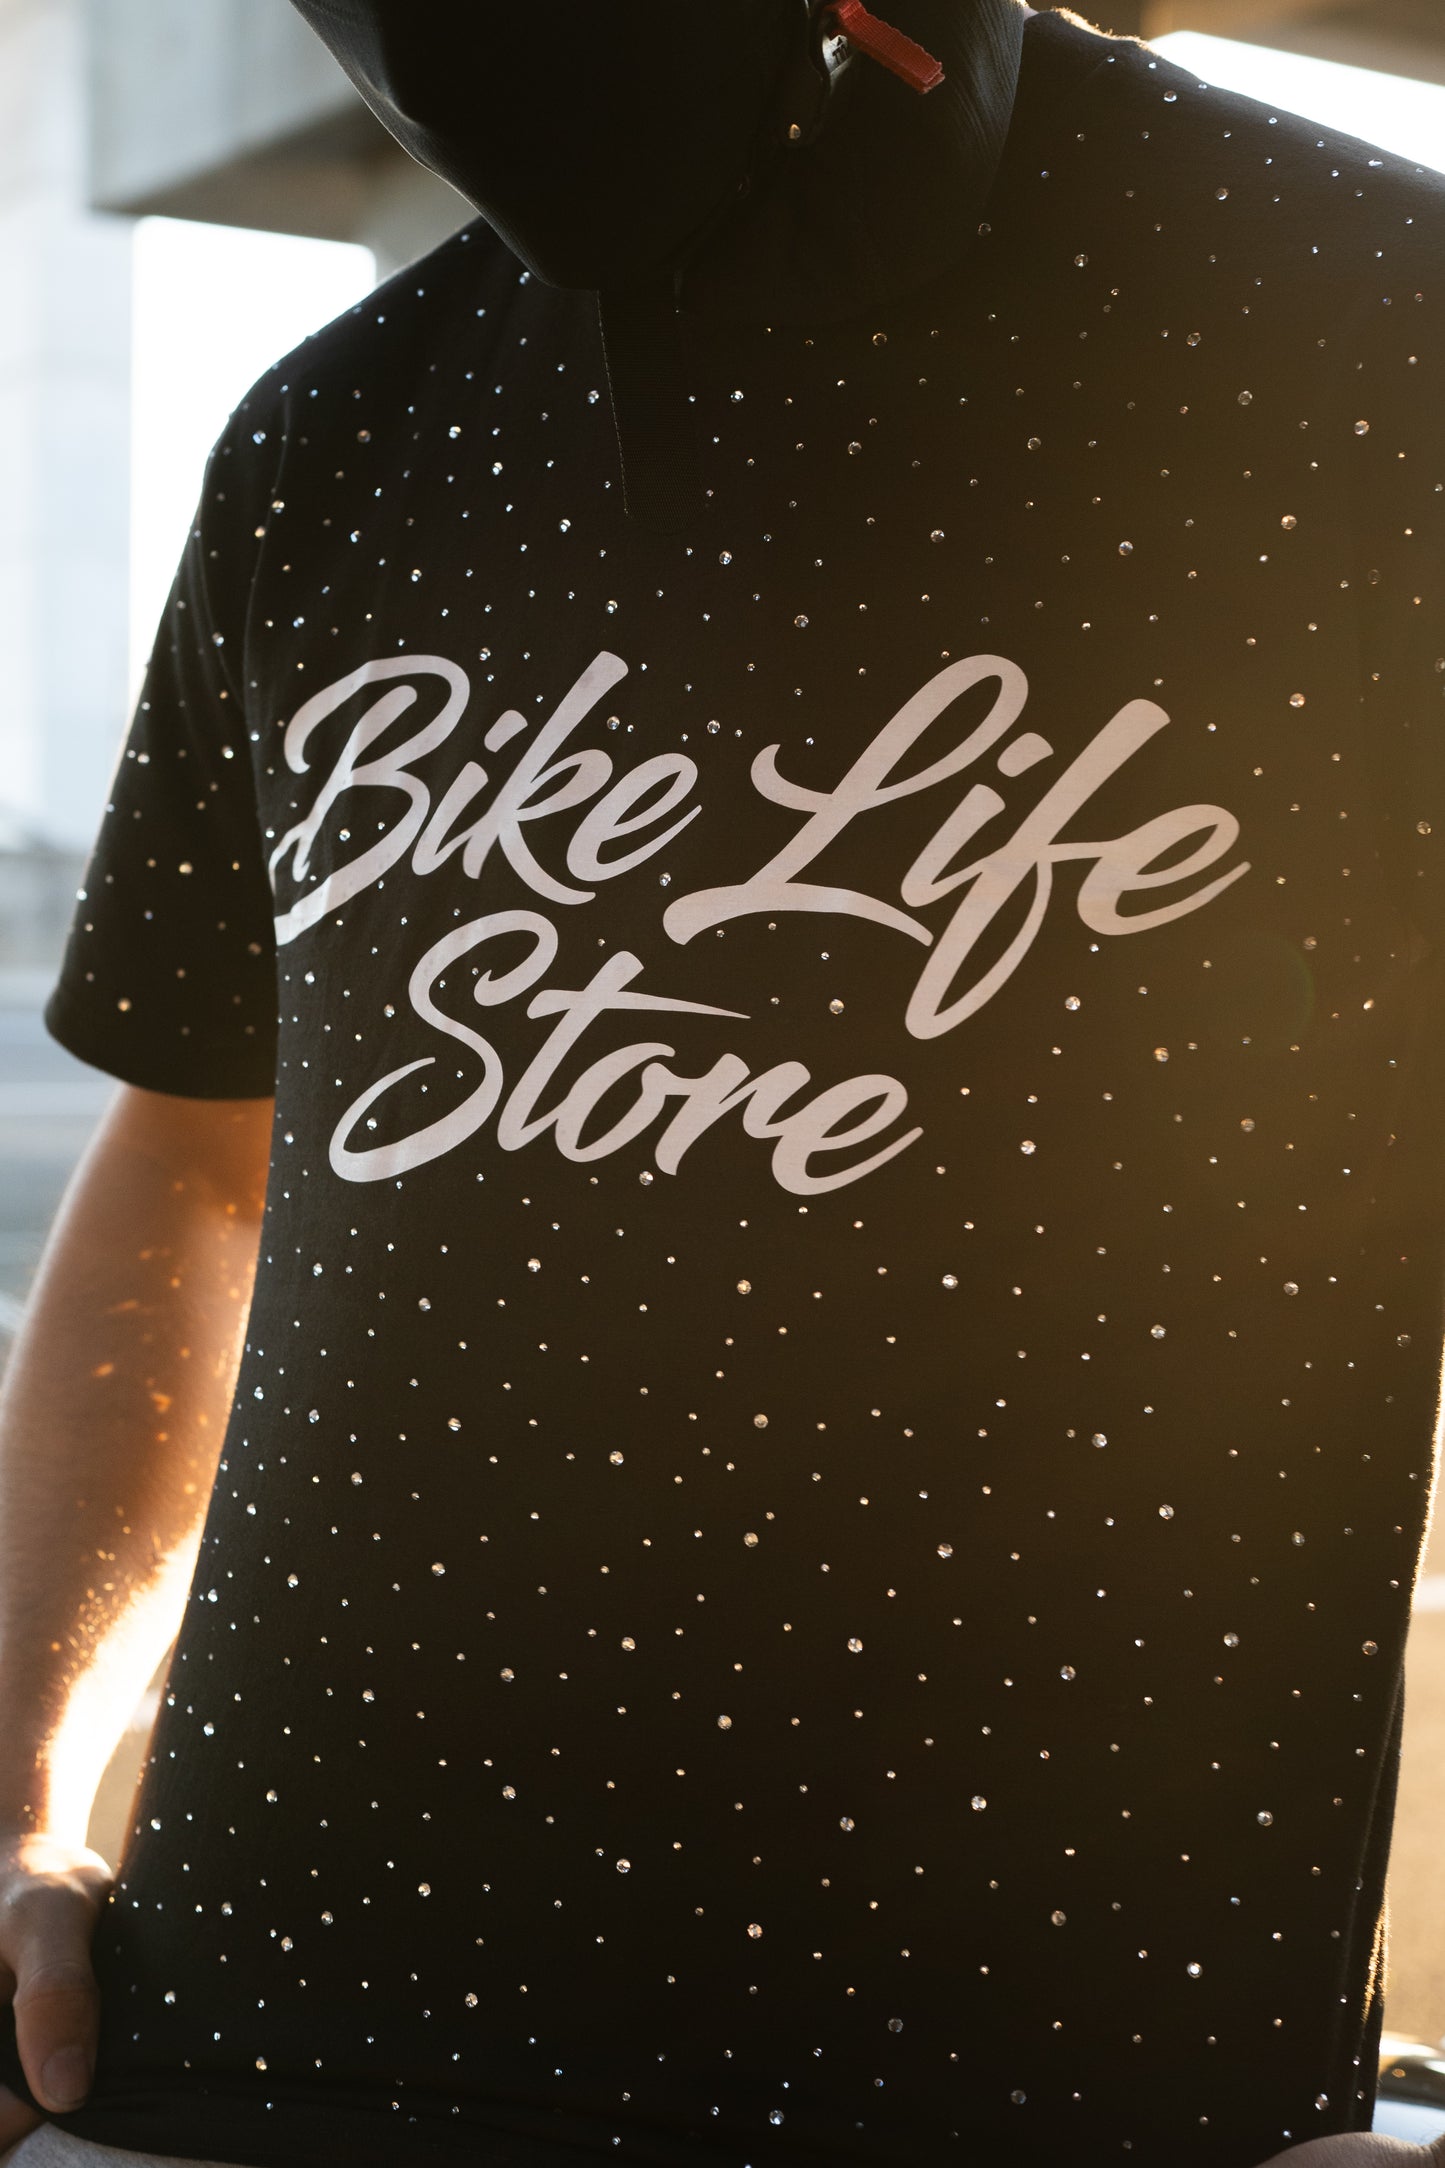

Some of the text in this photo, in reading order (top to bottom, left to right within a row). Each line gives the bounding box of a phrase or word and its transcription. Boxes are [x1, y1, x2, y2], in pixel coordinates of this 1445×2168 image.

[269, 651, 1251, 1040] Bike Life
[329, 910, 924, 1196] Store
